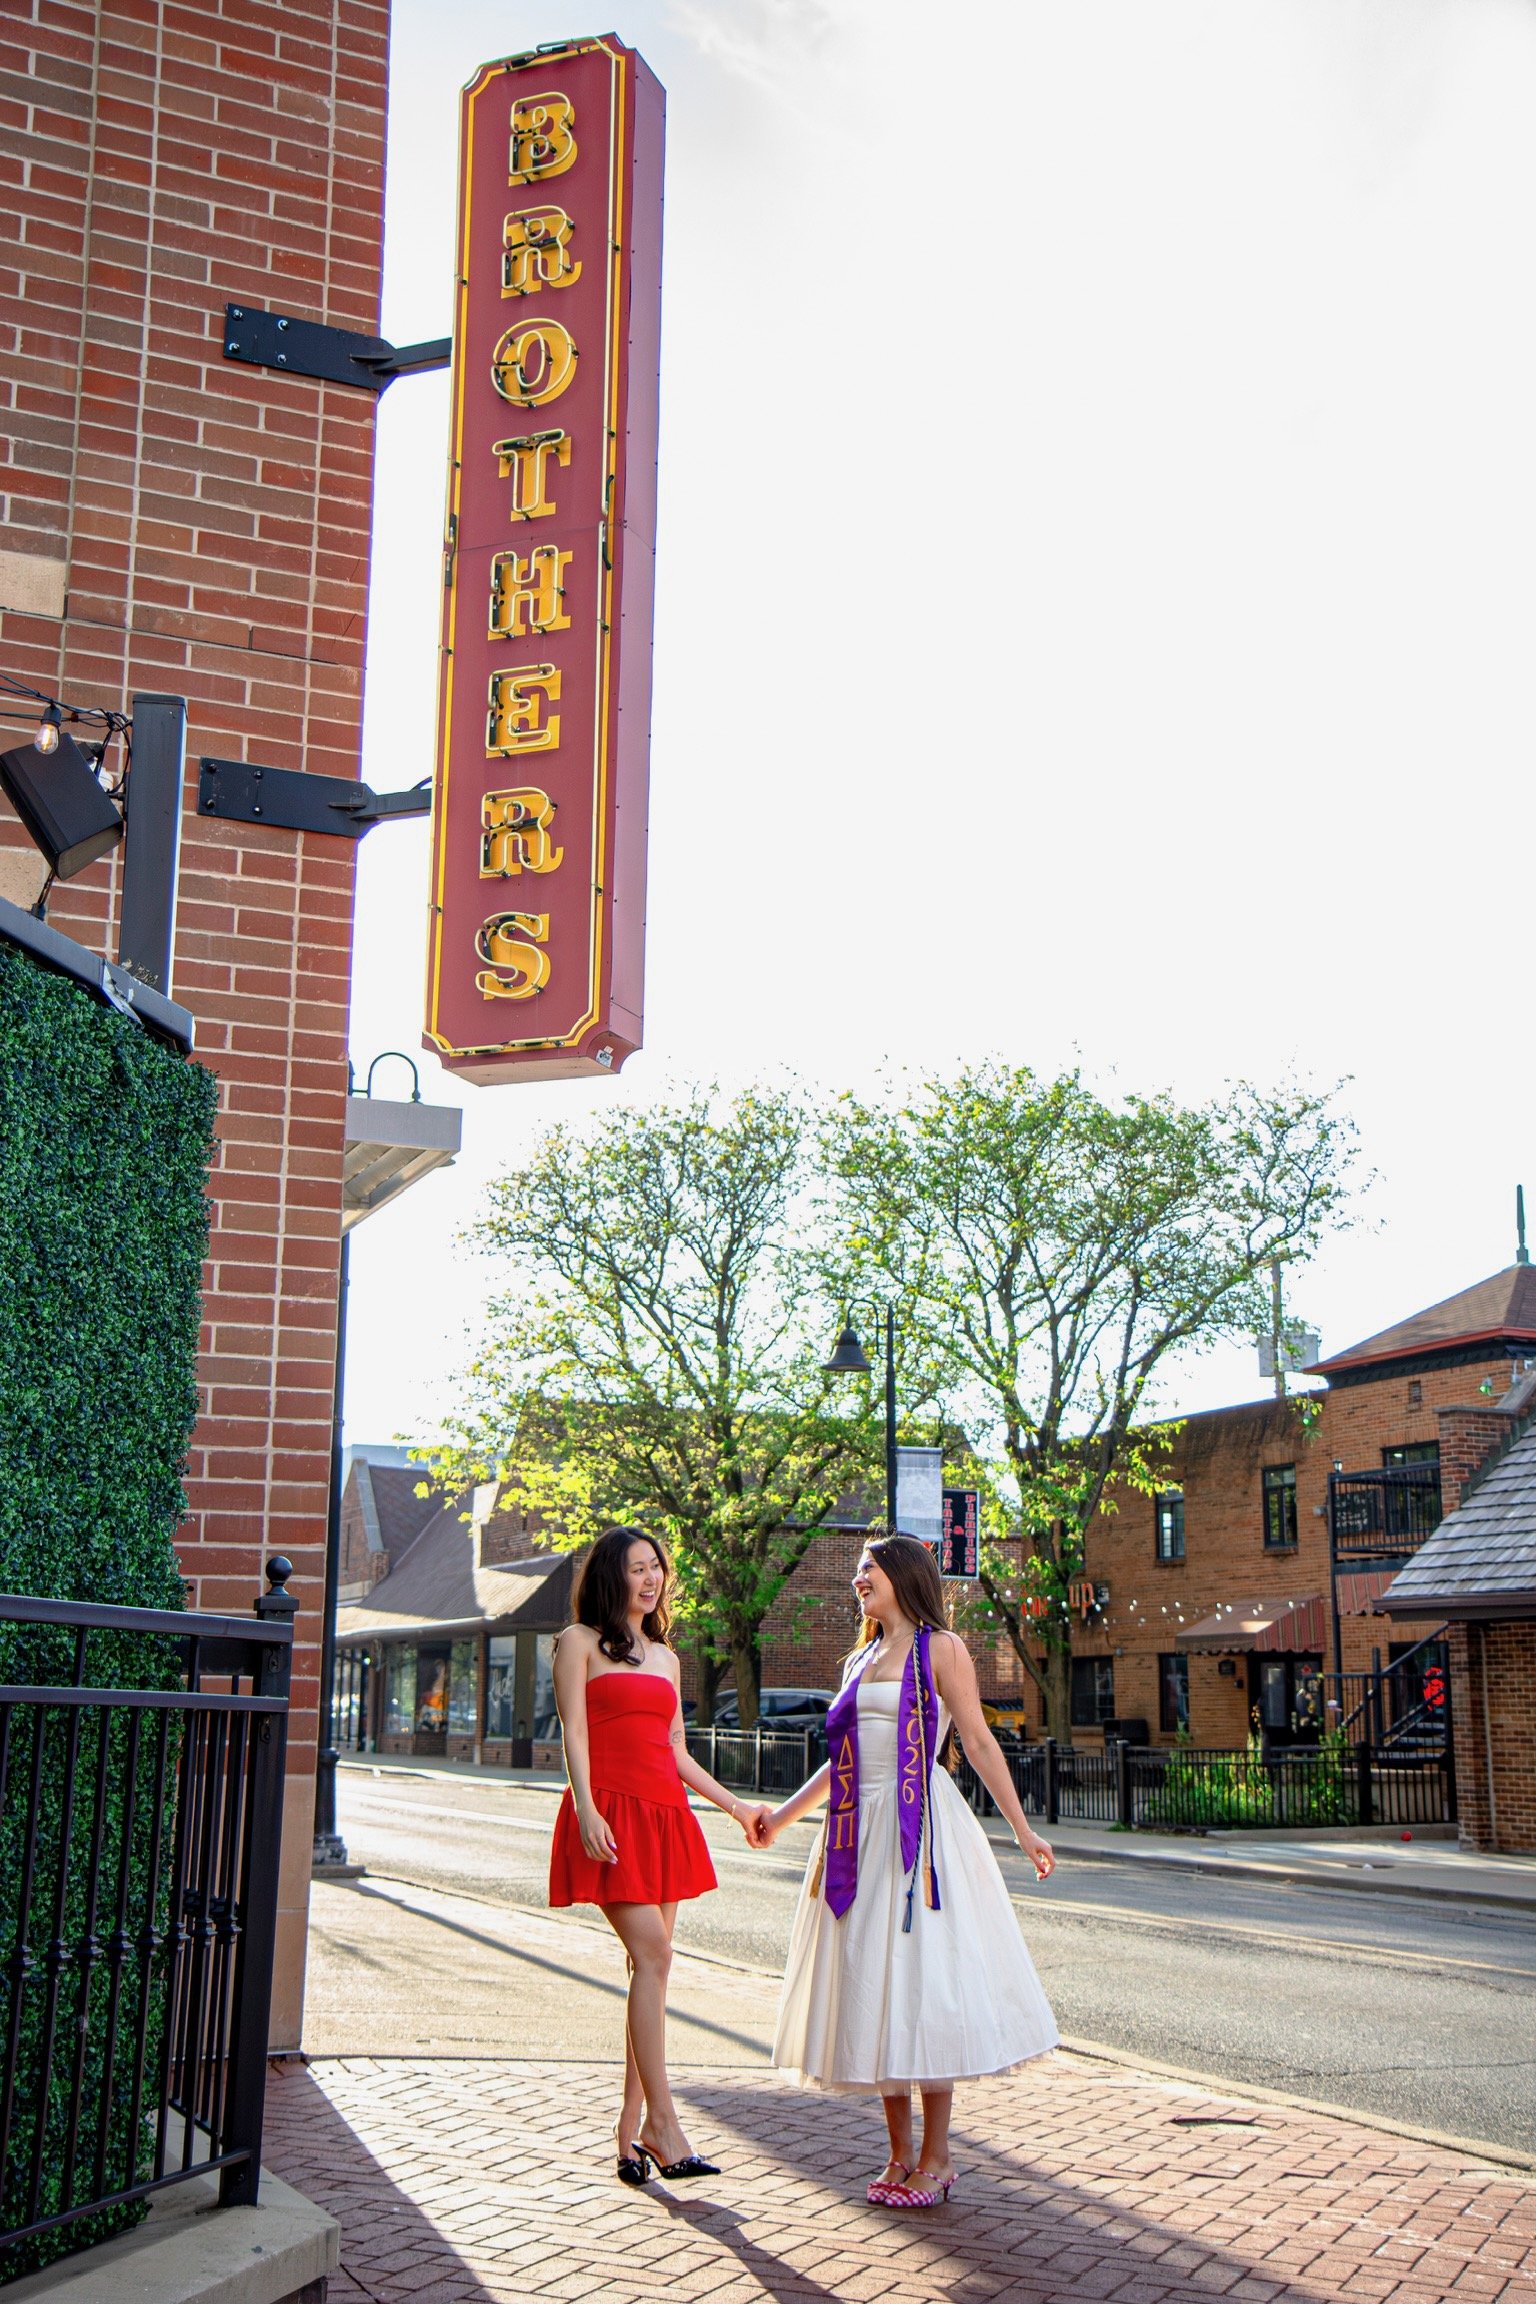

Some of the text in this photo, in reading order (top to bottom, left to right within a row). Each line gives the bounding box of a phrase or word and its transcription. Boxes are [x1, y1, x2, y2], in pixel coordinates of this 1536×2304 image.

[475, 91, 582, 1001] BROTHERS
[965, 1494, 976, 1573] PIERCINGS
[833, 1733, 855, 1850] ΔΣΠ
